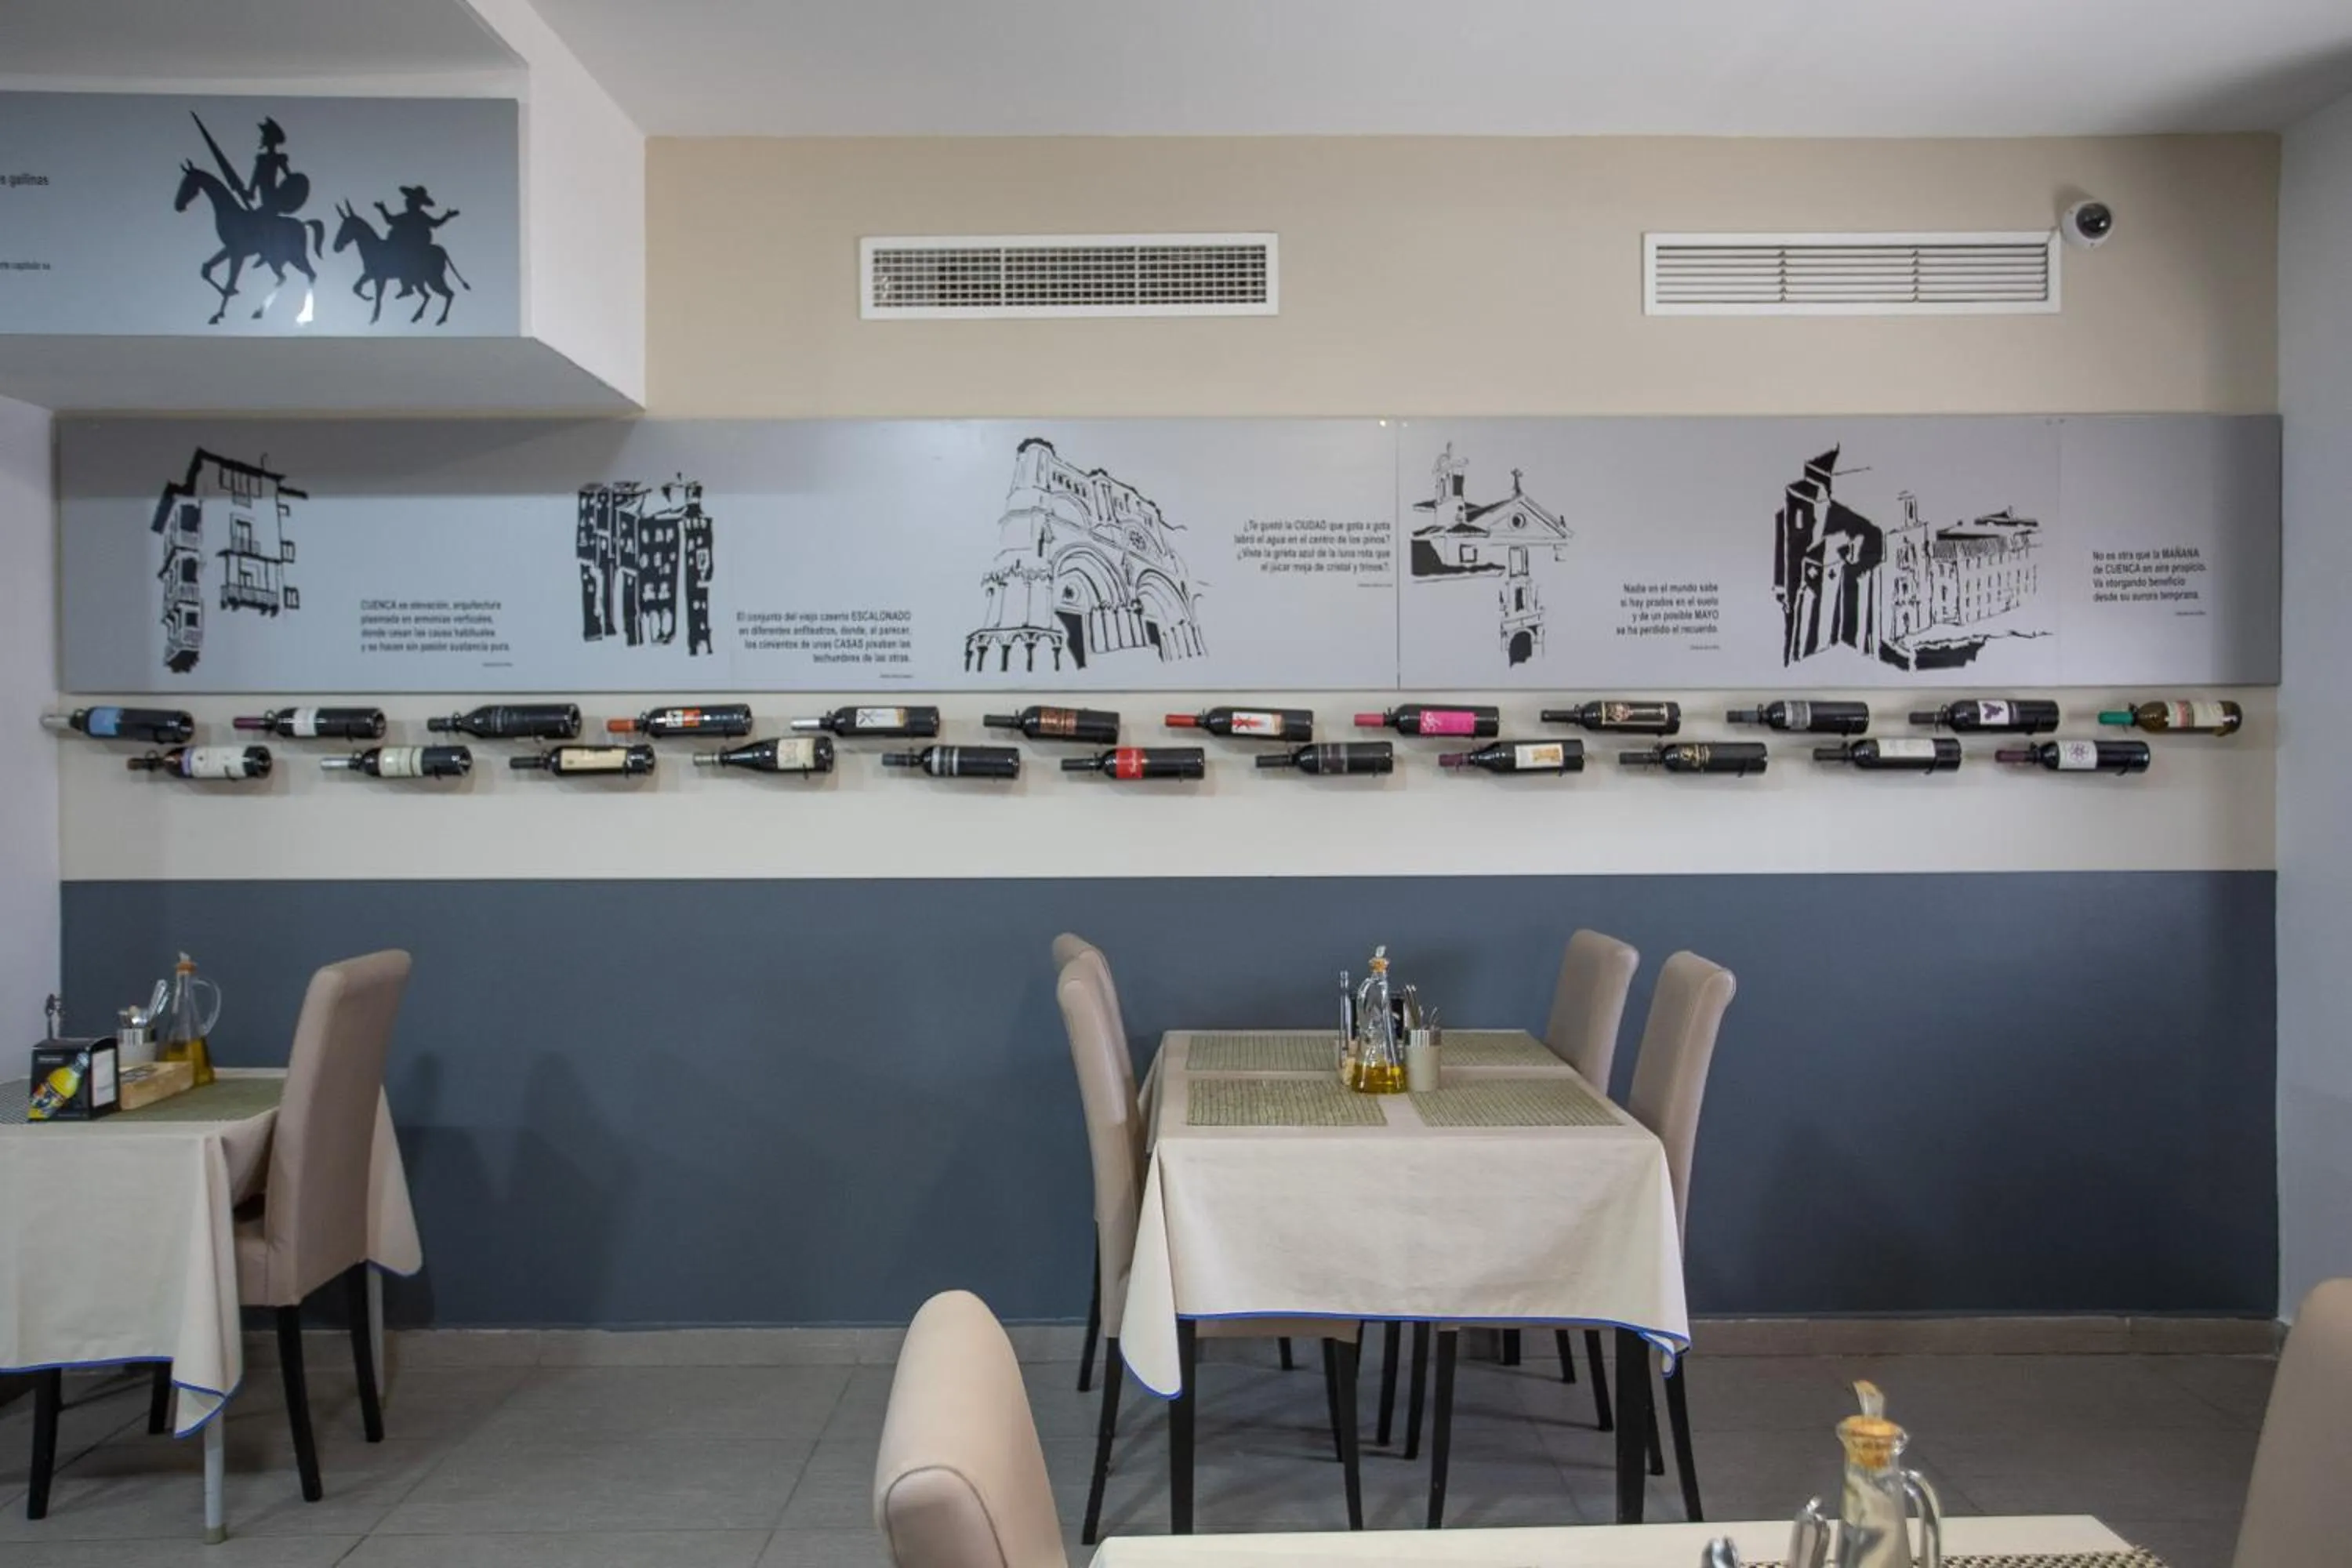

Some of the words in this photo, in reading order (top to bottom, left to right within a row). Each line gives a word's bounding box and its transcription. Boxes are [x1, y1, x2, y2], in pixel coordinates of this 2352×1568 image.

[1284, 521, 1292, 531] la
[1294, 519, 1327, 532] CIUDAD
[1329, 522, 1344, 532] que
[1265, 536, 1286, 547] agua
[1287, 536, 1298, 545] en
[1308, 535, 1335, 545] centro
[1337, 535, 1346, 545] de
[2161, 546, 2200, 559] MAÑANA
[2105, 563, 2140, 575] CUENCA
[1648, 584, 1658, 593] en
[1669, 583, 1697, 593] mundo
[360, 600, 396, 611] CUENCA
[851, 610, 911, 622] ESCALONADO
[1694, 609, 1719, 620] MAYO
[833, 638, 863, 649] CASAS
